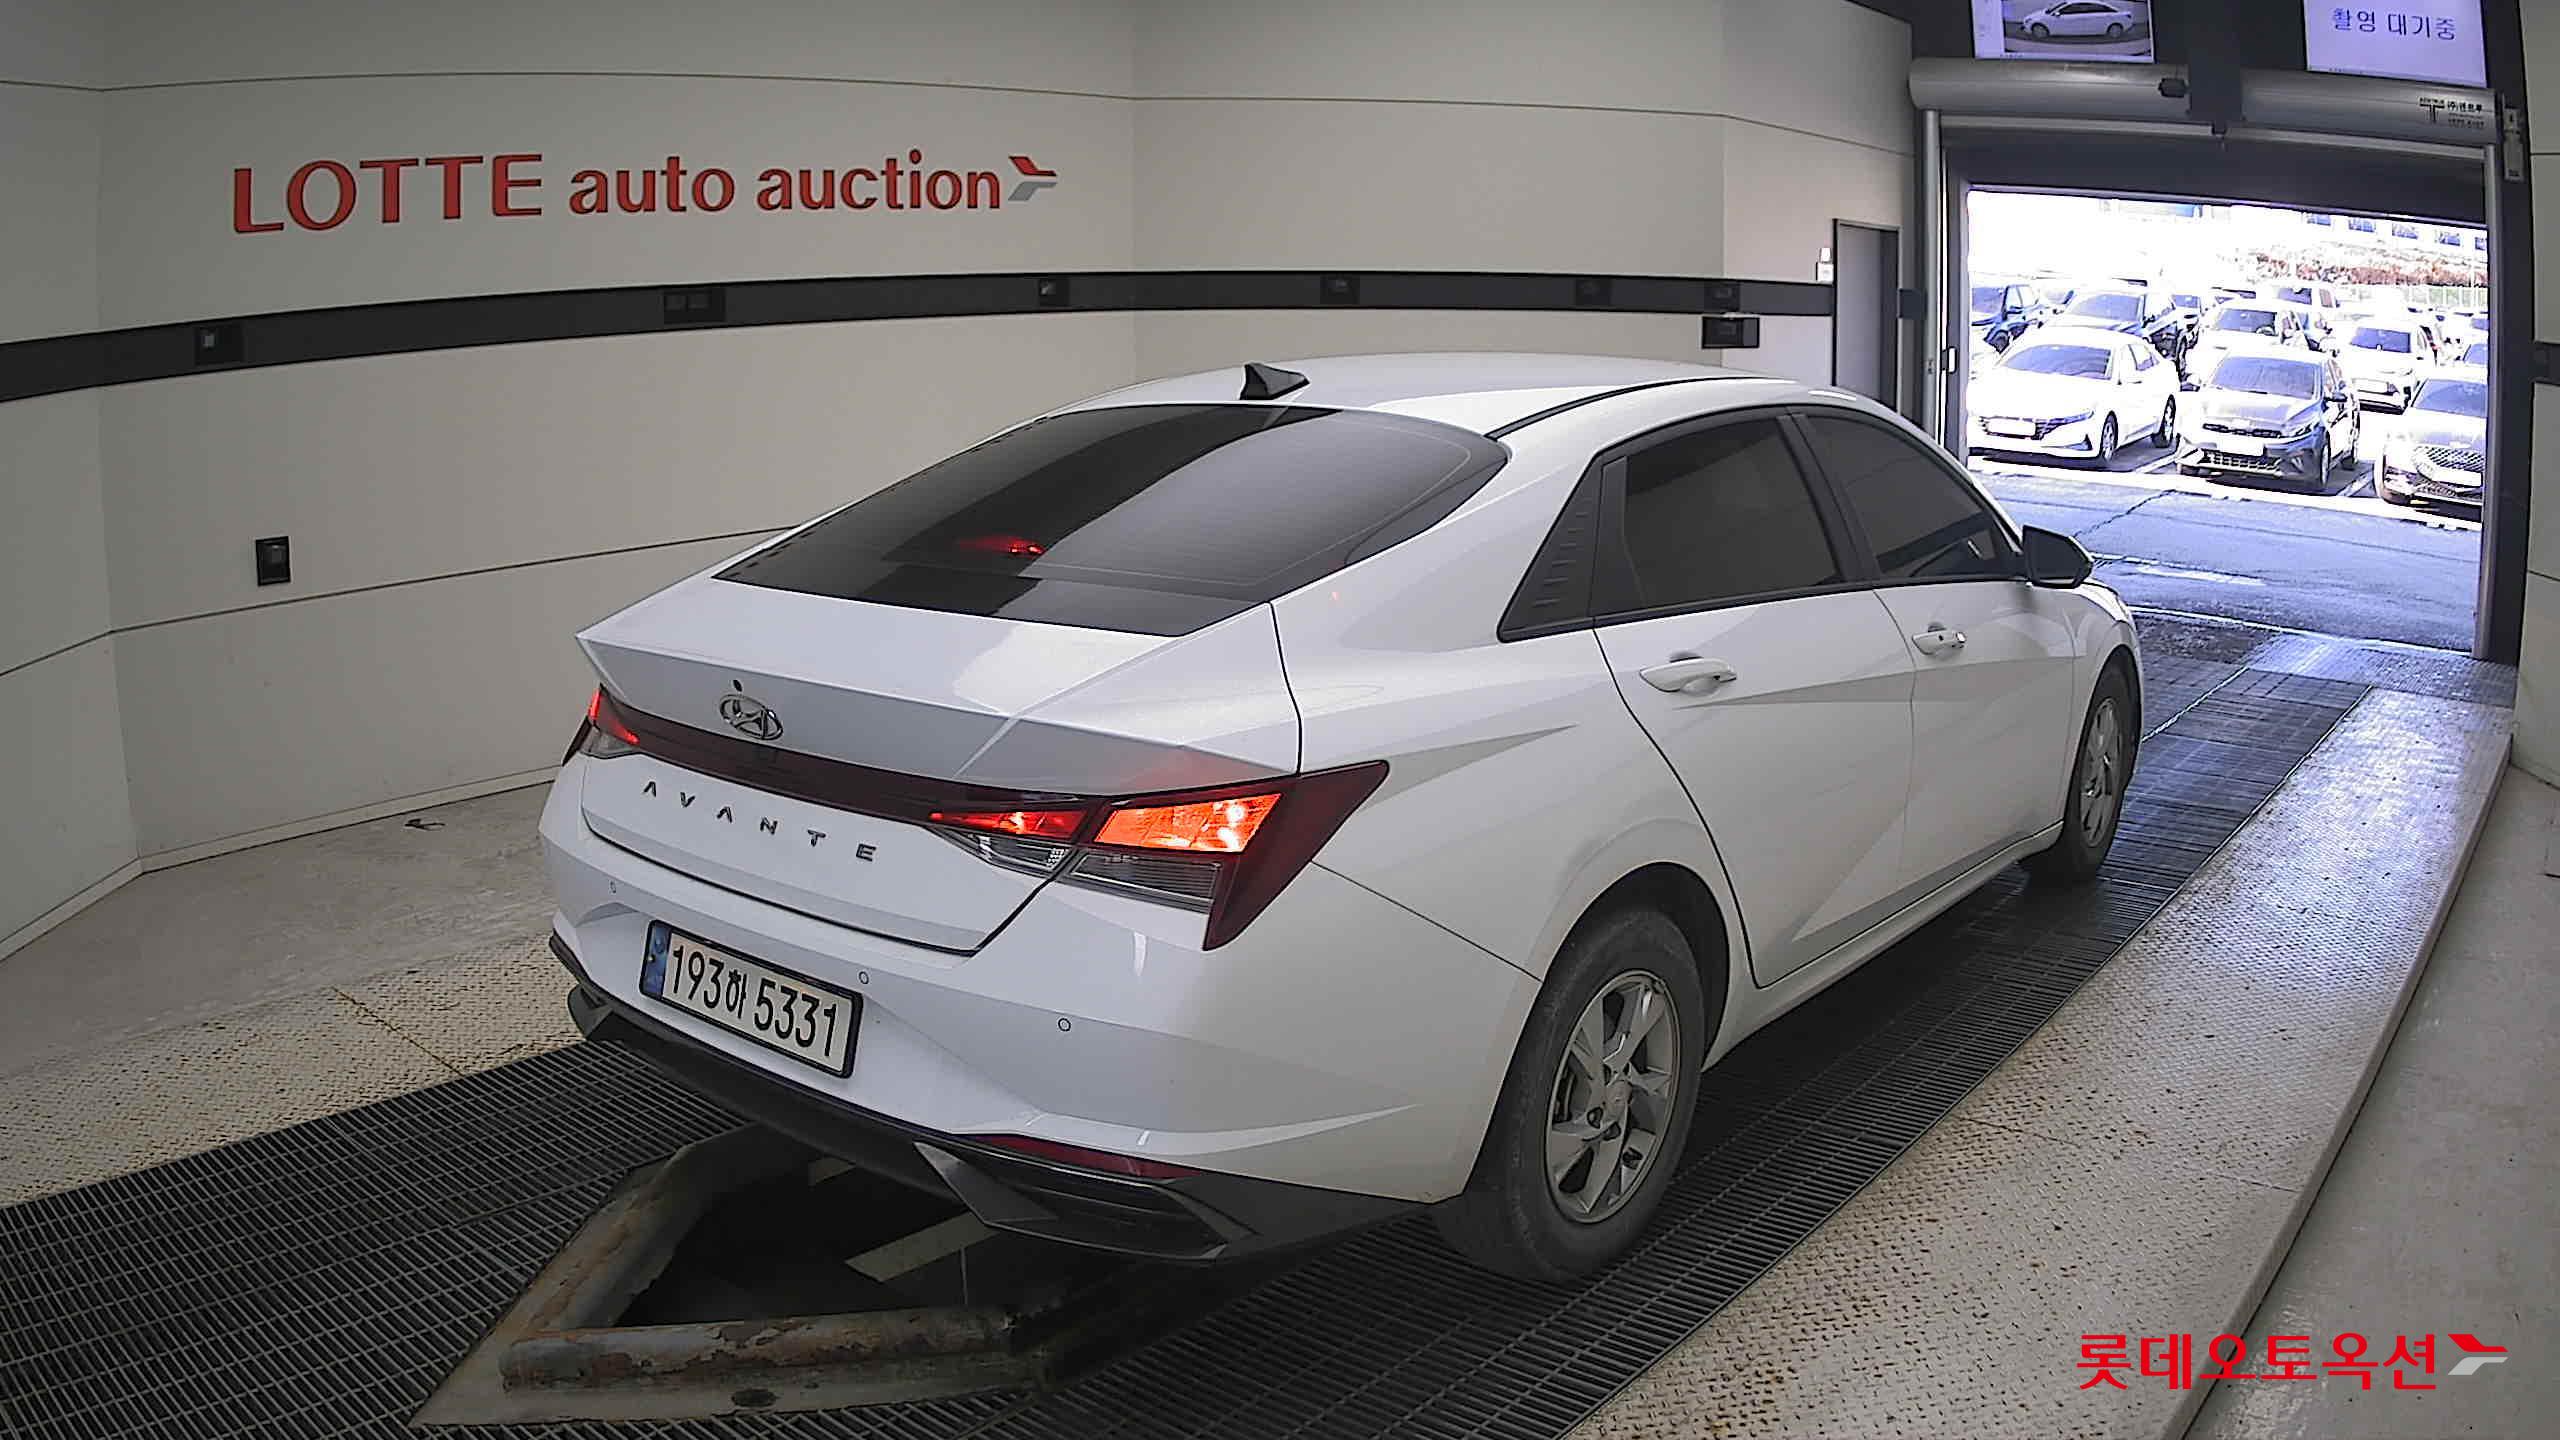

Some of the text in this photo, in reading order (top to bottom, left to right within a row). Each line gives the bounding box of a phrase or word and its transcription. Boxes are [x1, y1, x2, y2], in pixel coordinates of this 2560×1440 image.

[2332, 7, 2456, 40] 촬영 대기중
[233, 150, 1003, 233] LOTTE auto auction
[643, 780, 878, 863] AVANTE
[672, 945, 837, 1057] 193하 5331
